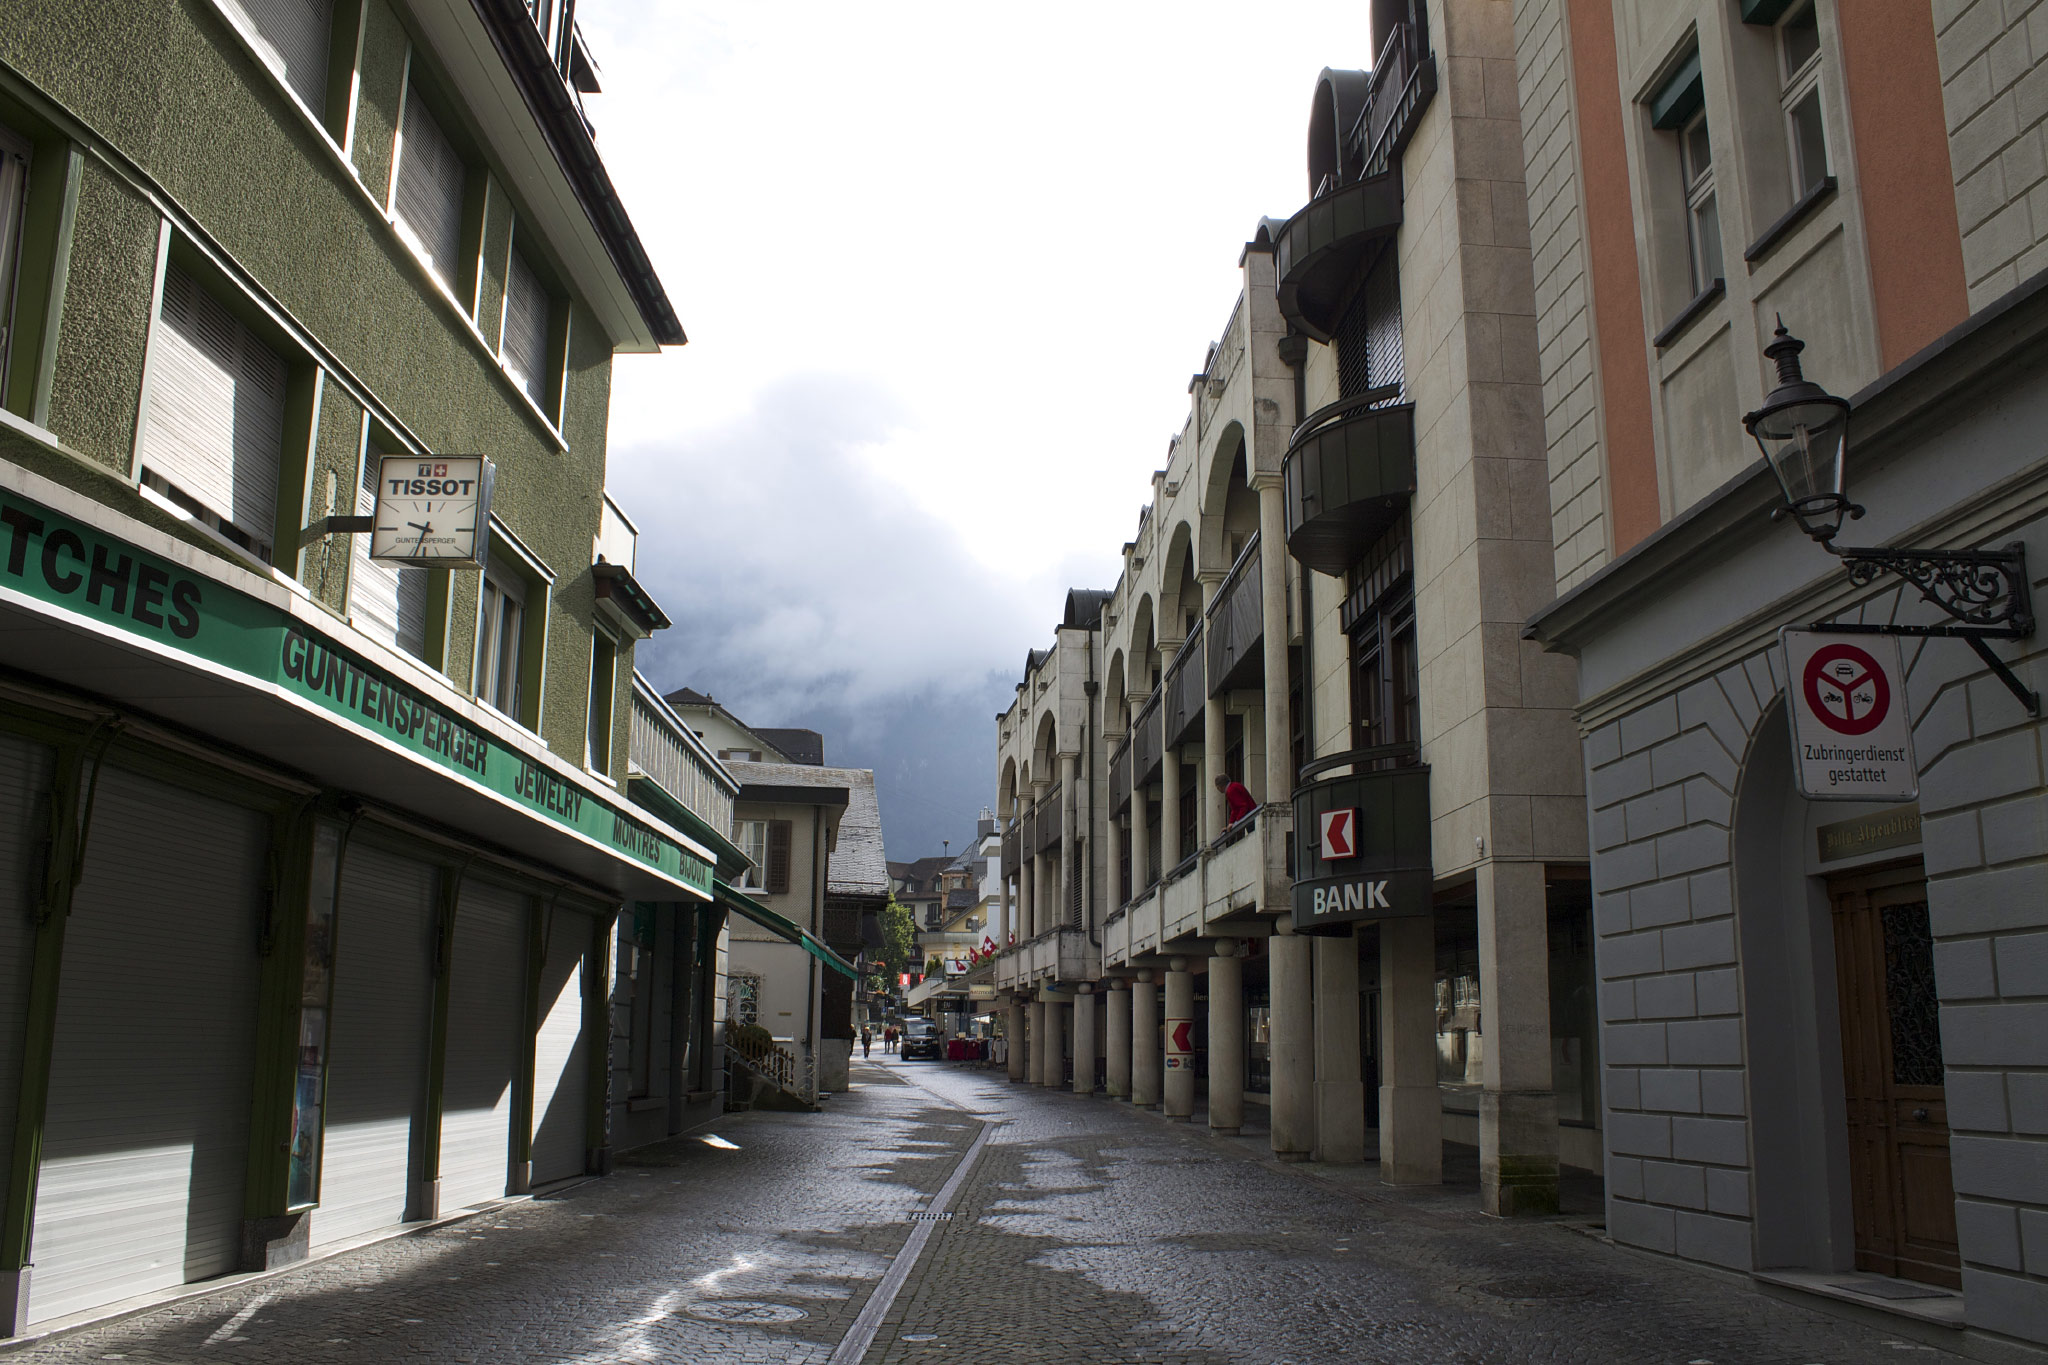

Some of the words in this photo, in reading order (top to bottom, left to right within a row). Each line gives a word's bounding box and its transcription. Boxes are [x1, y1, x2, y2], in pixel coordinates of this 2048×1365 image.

[388, 479, 475, 496] TISSOT
[1, 504, 202, 640] TCHES
[282, 626, 488, 776] GUNTENSPERGER
[515, 760, 583, 822] JEWELRY
[613, 815, 660, 864] MONTRES
[679, 849, 706, 887] BIJOUX
[1804, 744, 1905, 764] Zubringerdienst
[1829, 768, 1887, 785] gestattet
[1313, 880, 1391, 915] BANK
